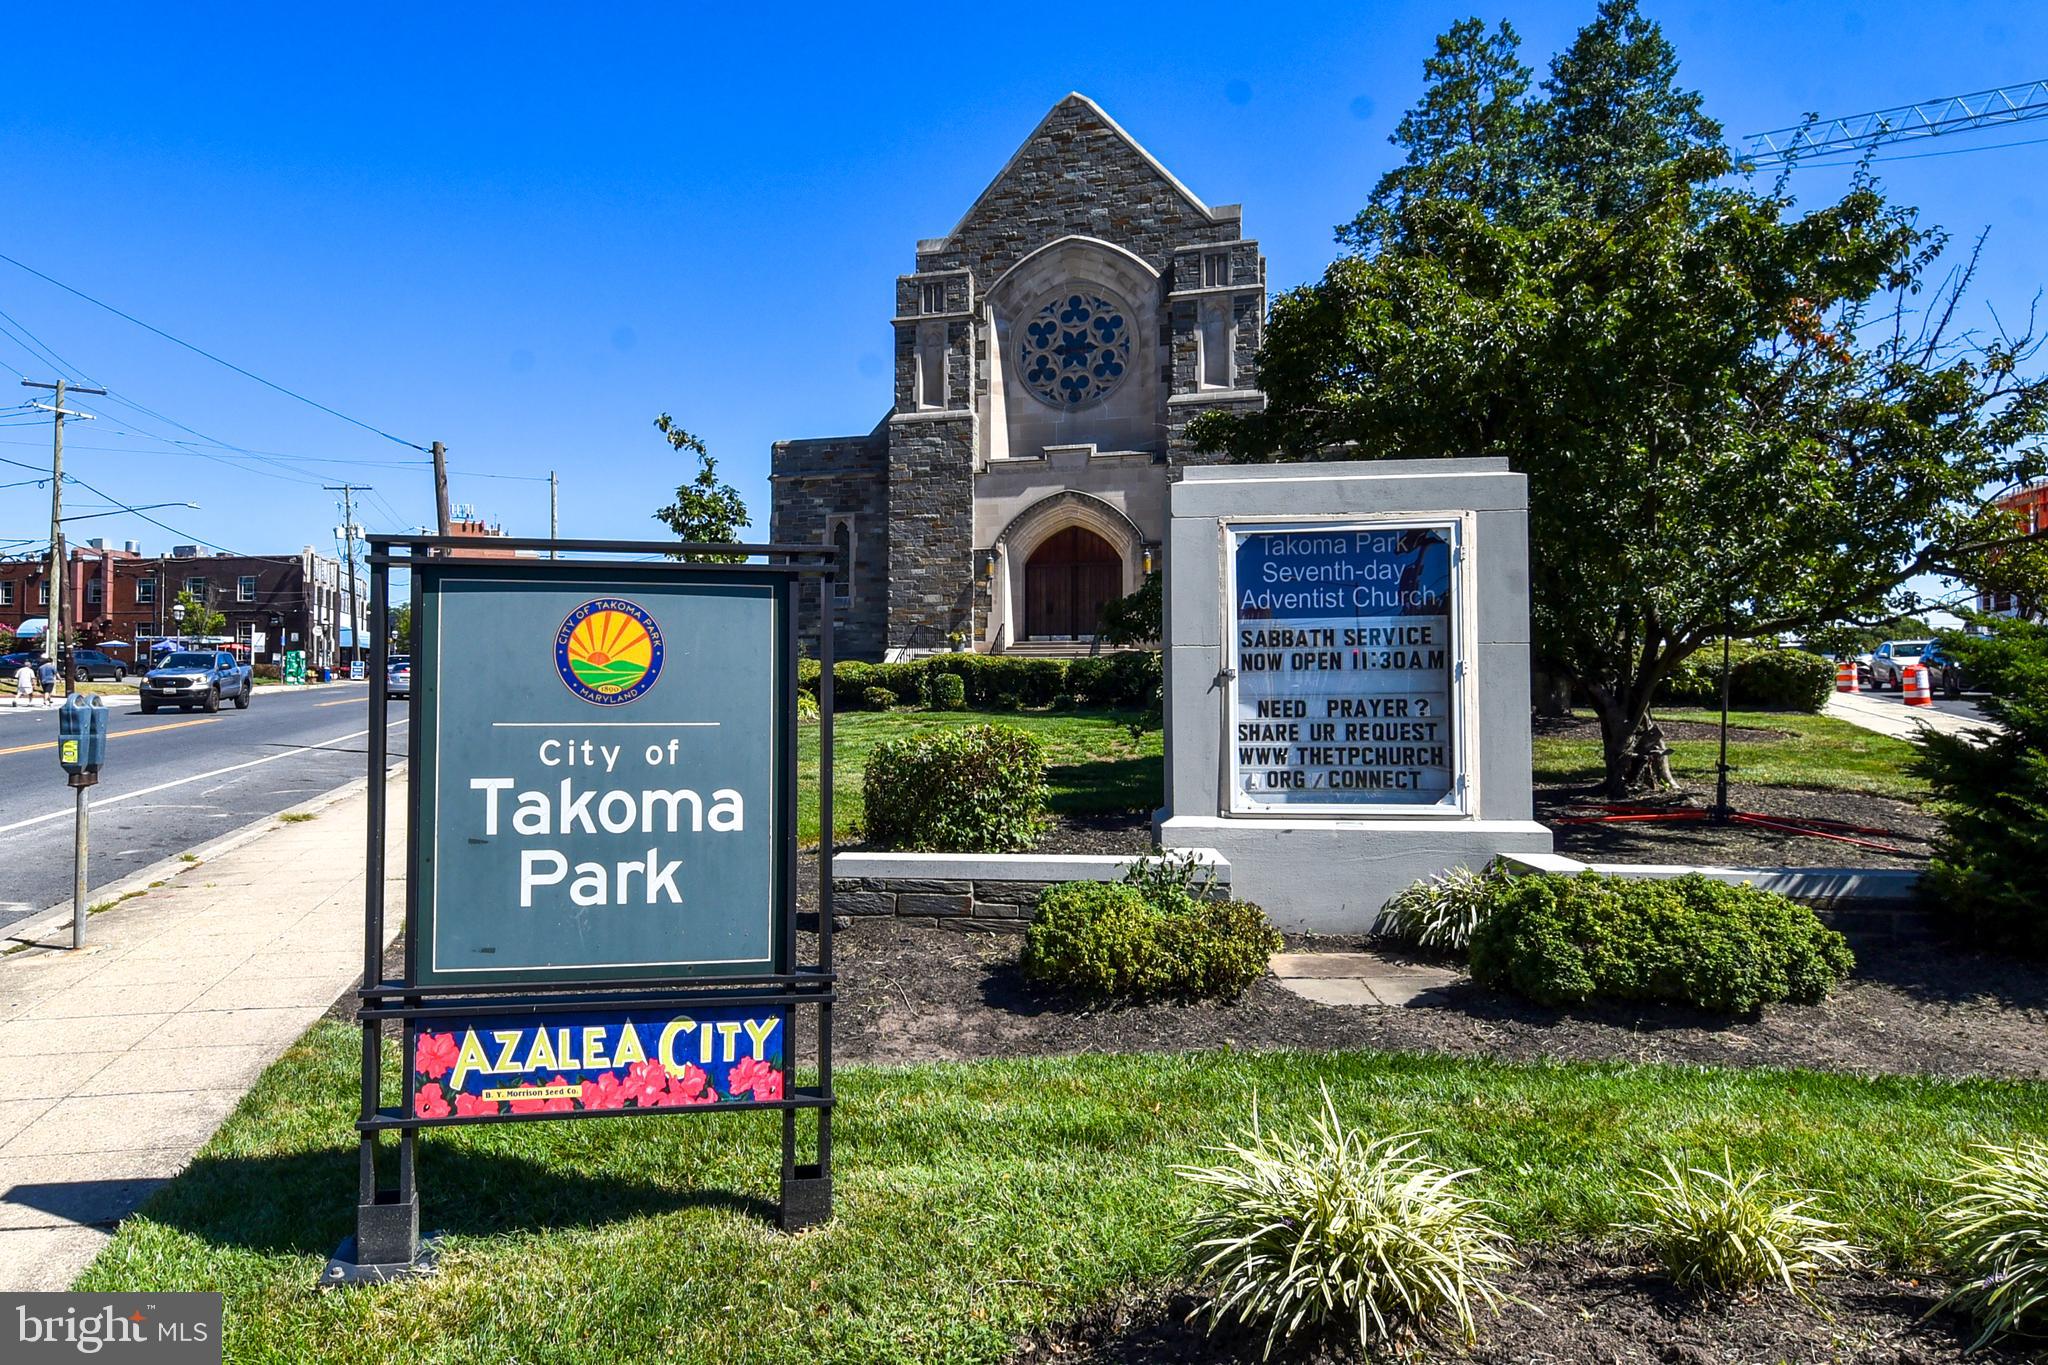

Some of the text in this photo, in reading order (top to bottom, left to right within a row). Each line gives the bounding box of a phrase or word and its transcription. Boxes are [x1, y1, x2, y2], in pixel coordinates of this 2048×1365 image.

[1260, 531, 1408, 556] Takoma Park
[1263, 560, 1406, 584] Seventh-day
[1241, 585, 1436, 610] Adventist Church
[559, 601, 662, 647] CITY OF TAKOMA PARK
[1241, 627, 1432, 648] SABBATH SERVICE
[1241, 652, 1283, 671] NOW
[1291, 651, 1342, 670] OPEN
[580, 688, 638, 703] MARYLAND
[1257, 700, 1307, 718] NEED
[1239, 722, 1438, 742] SHARE UR REQUEST
[539, 738, 680, 772] City of
[1296, 747, 1443, 766] THETPCHURCH
[469, 777, 744, 835] Takoma
[520, 847, 684, 908] Park
[449, 1015, 780, 1091] AZALEA CITY
[506, 1088, 543, 1098] Morrison
[545, 1088, 564, 1096] Seed
[566, 1087, 579, 1095] Co.
